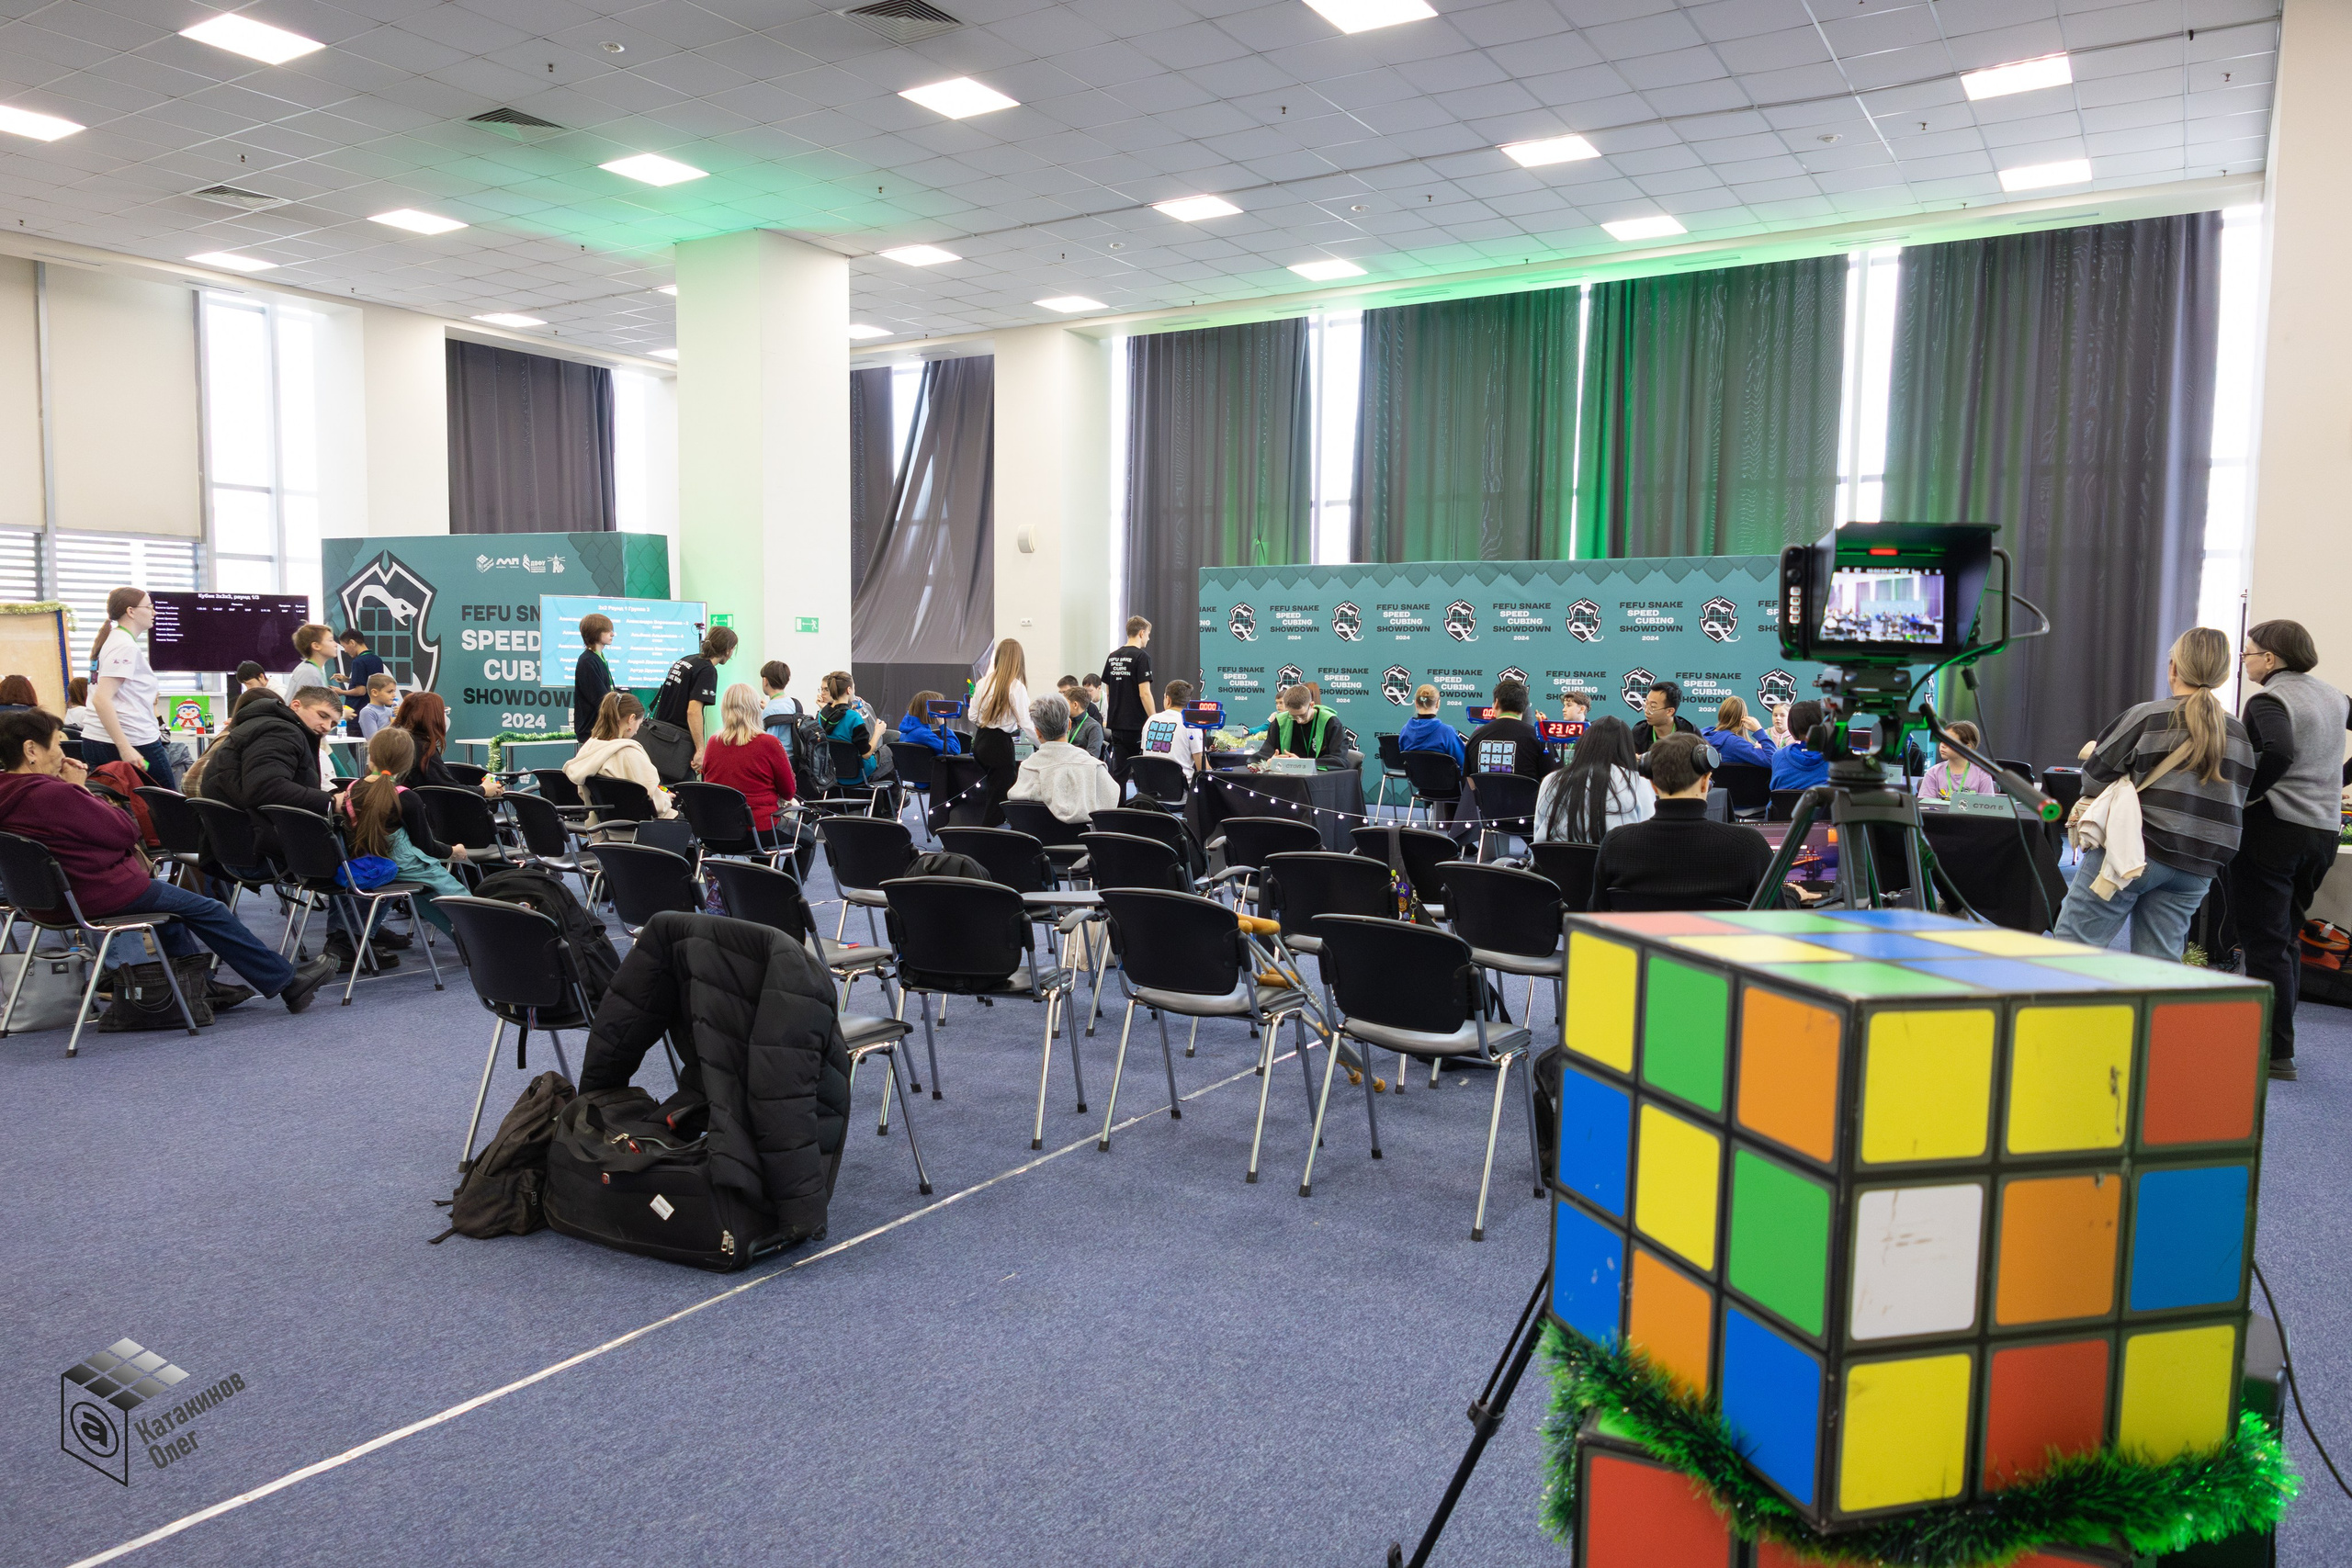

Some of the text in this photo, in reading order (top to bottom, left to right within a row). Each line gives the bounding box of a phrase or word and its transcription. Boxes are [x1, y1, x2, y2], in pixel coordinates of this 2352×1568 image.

[461, 604, 511, 621] FEFU
[461, 629, 540, 651] SPEED
[483, 659, 540, 682] CUB
[463, 687, 575, 707] SHOWDOW
[502, 712, 547, 728] 2024
